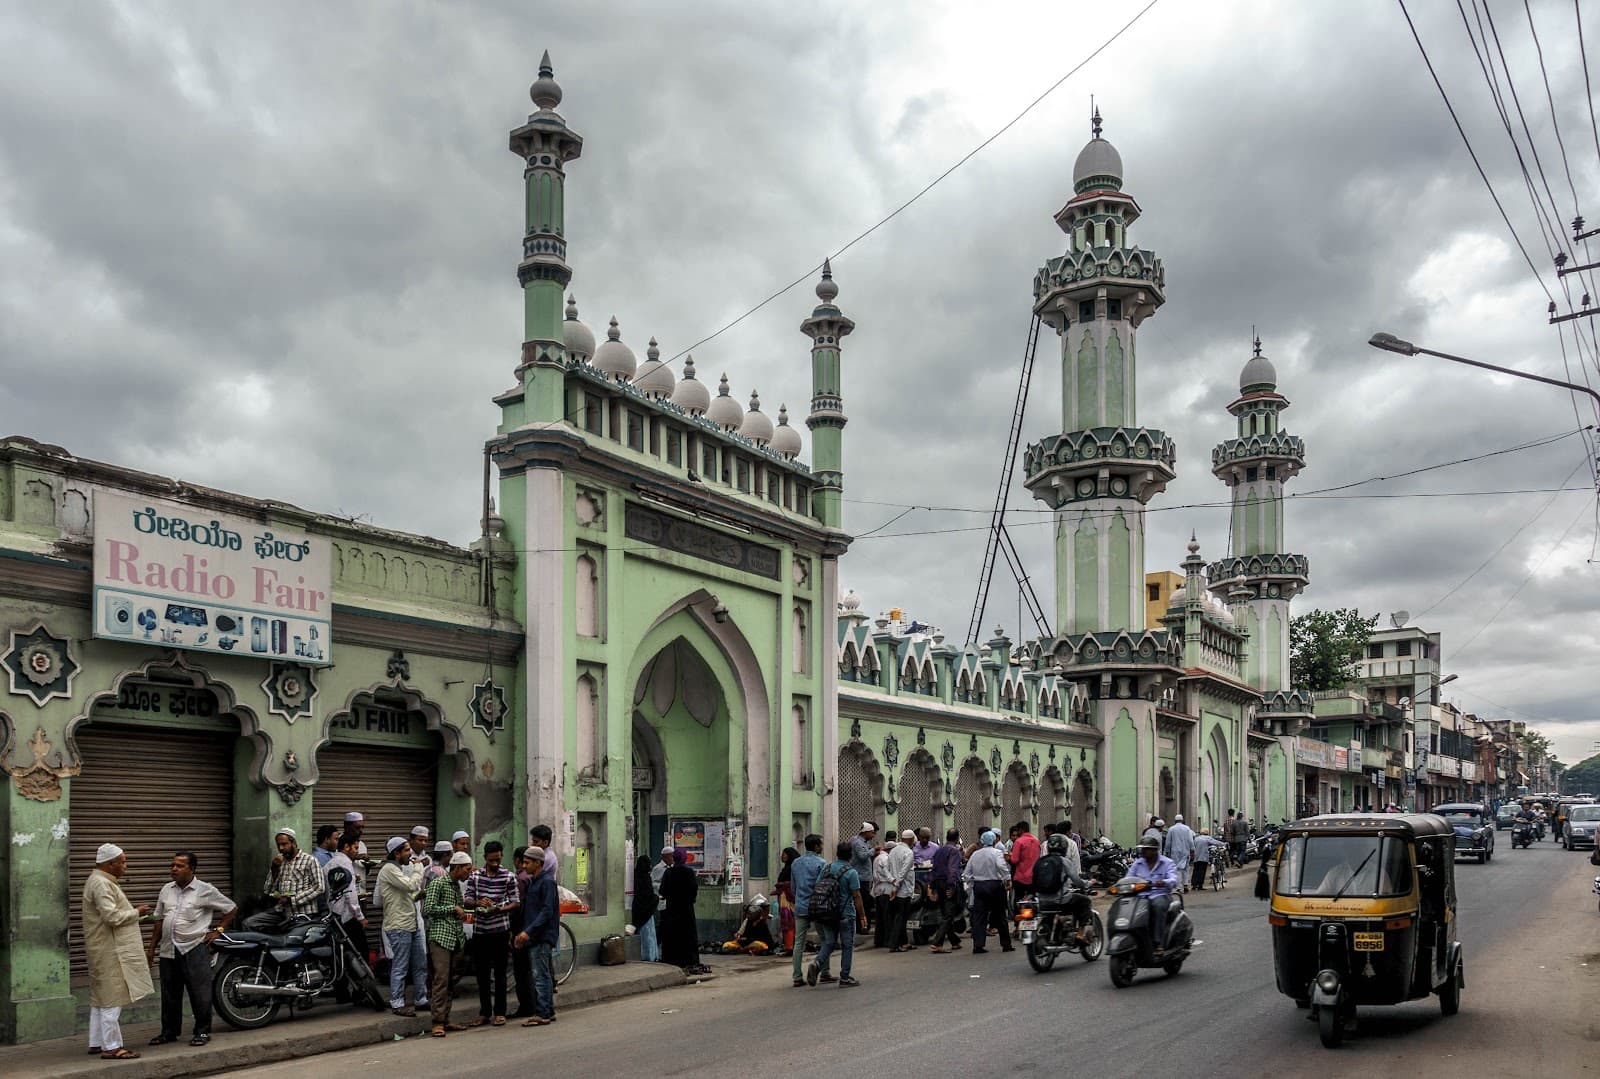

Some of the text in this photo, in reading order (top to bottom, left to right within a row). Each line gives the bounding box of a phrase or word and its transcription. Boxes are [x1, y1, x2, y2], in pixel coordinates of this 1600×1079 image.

[105, 539, 325, 612] Radio Fair
[366, 710, 409, 735] FAIR
[1355, 940, 1383, 950] 6956
